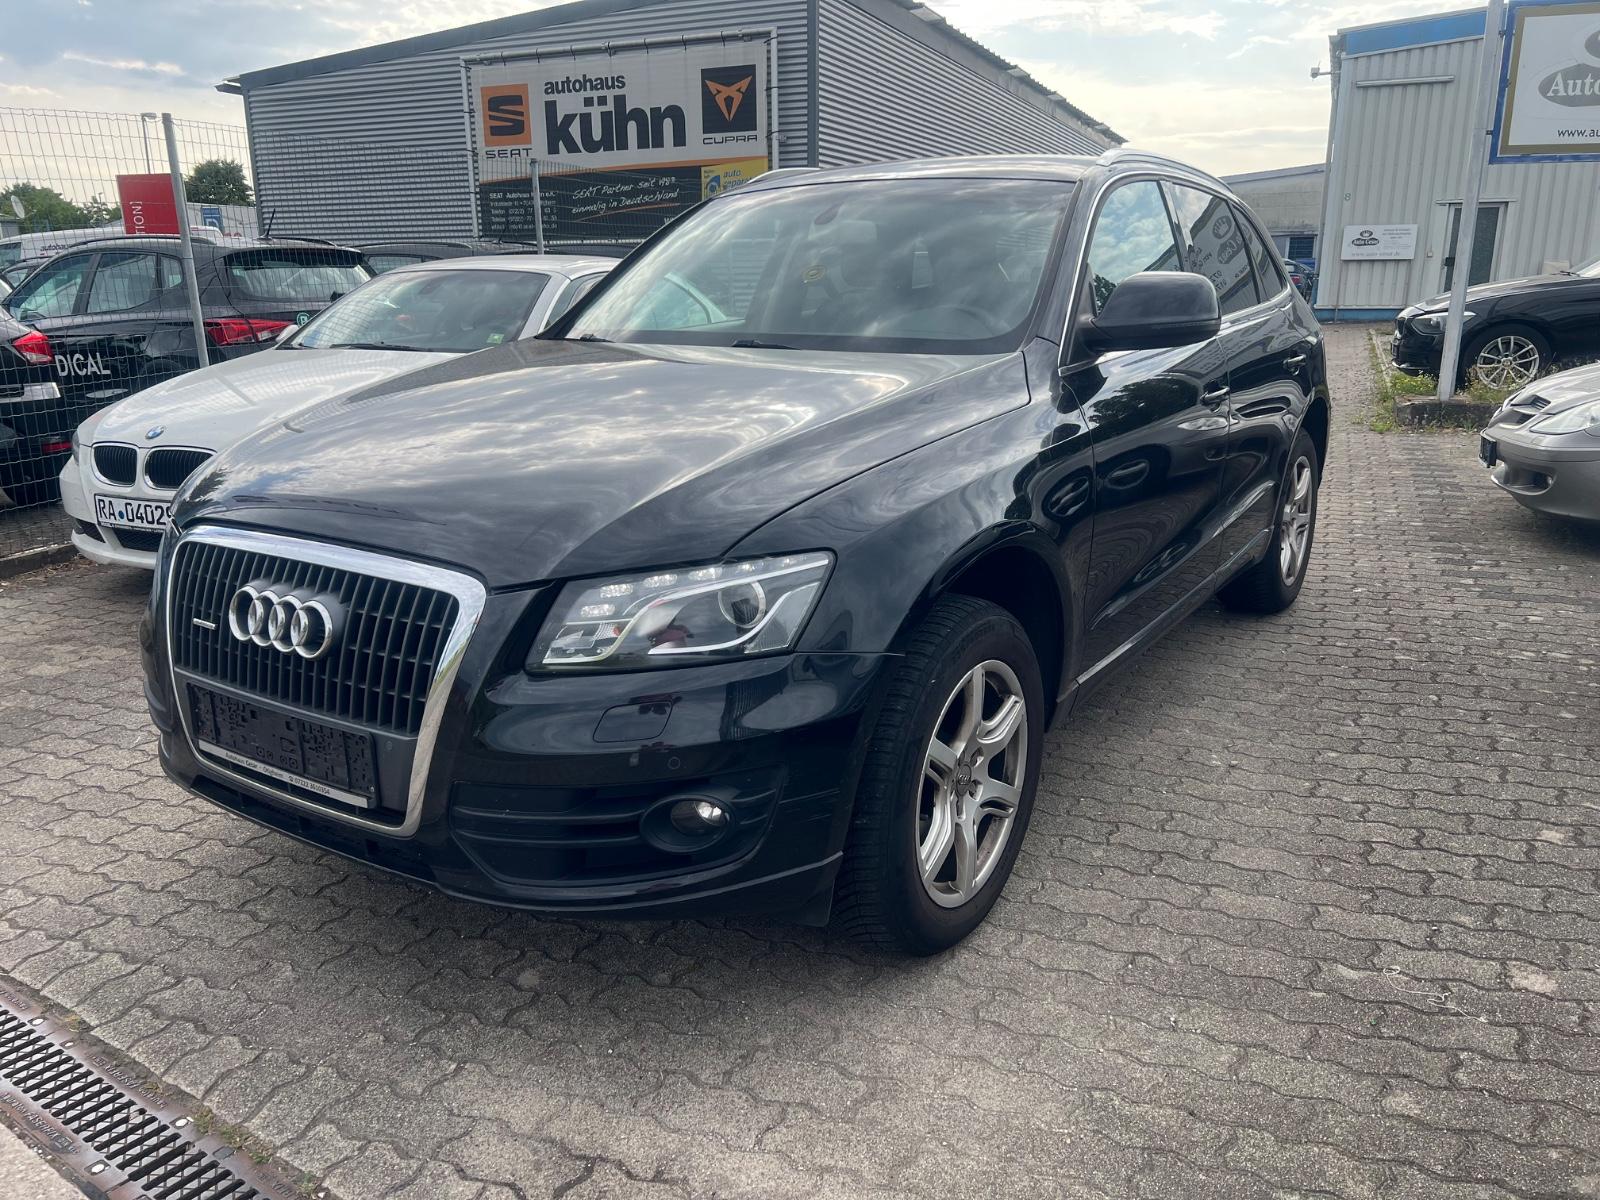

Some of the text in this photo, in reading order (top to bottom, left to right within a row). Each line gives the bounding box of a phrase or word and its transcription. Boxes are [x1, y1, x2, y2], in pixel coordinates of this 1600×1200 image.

[544, 74, 626, 95] autohaus
[544, 94, 687, 155] kühn
[702, 134, 758, 145] CUPRA
[485, 148, 533, 159] SEAT
[572, 186, 600, 199] SEAT
[601, 183, 633, 195] Partner
[608, 199, 617, 208] in
[619, 188, 680, 207] Deutschland
[97, 498, 117, 521] RA
